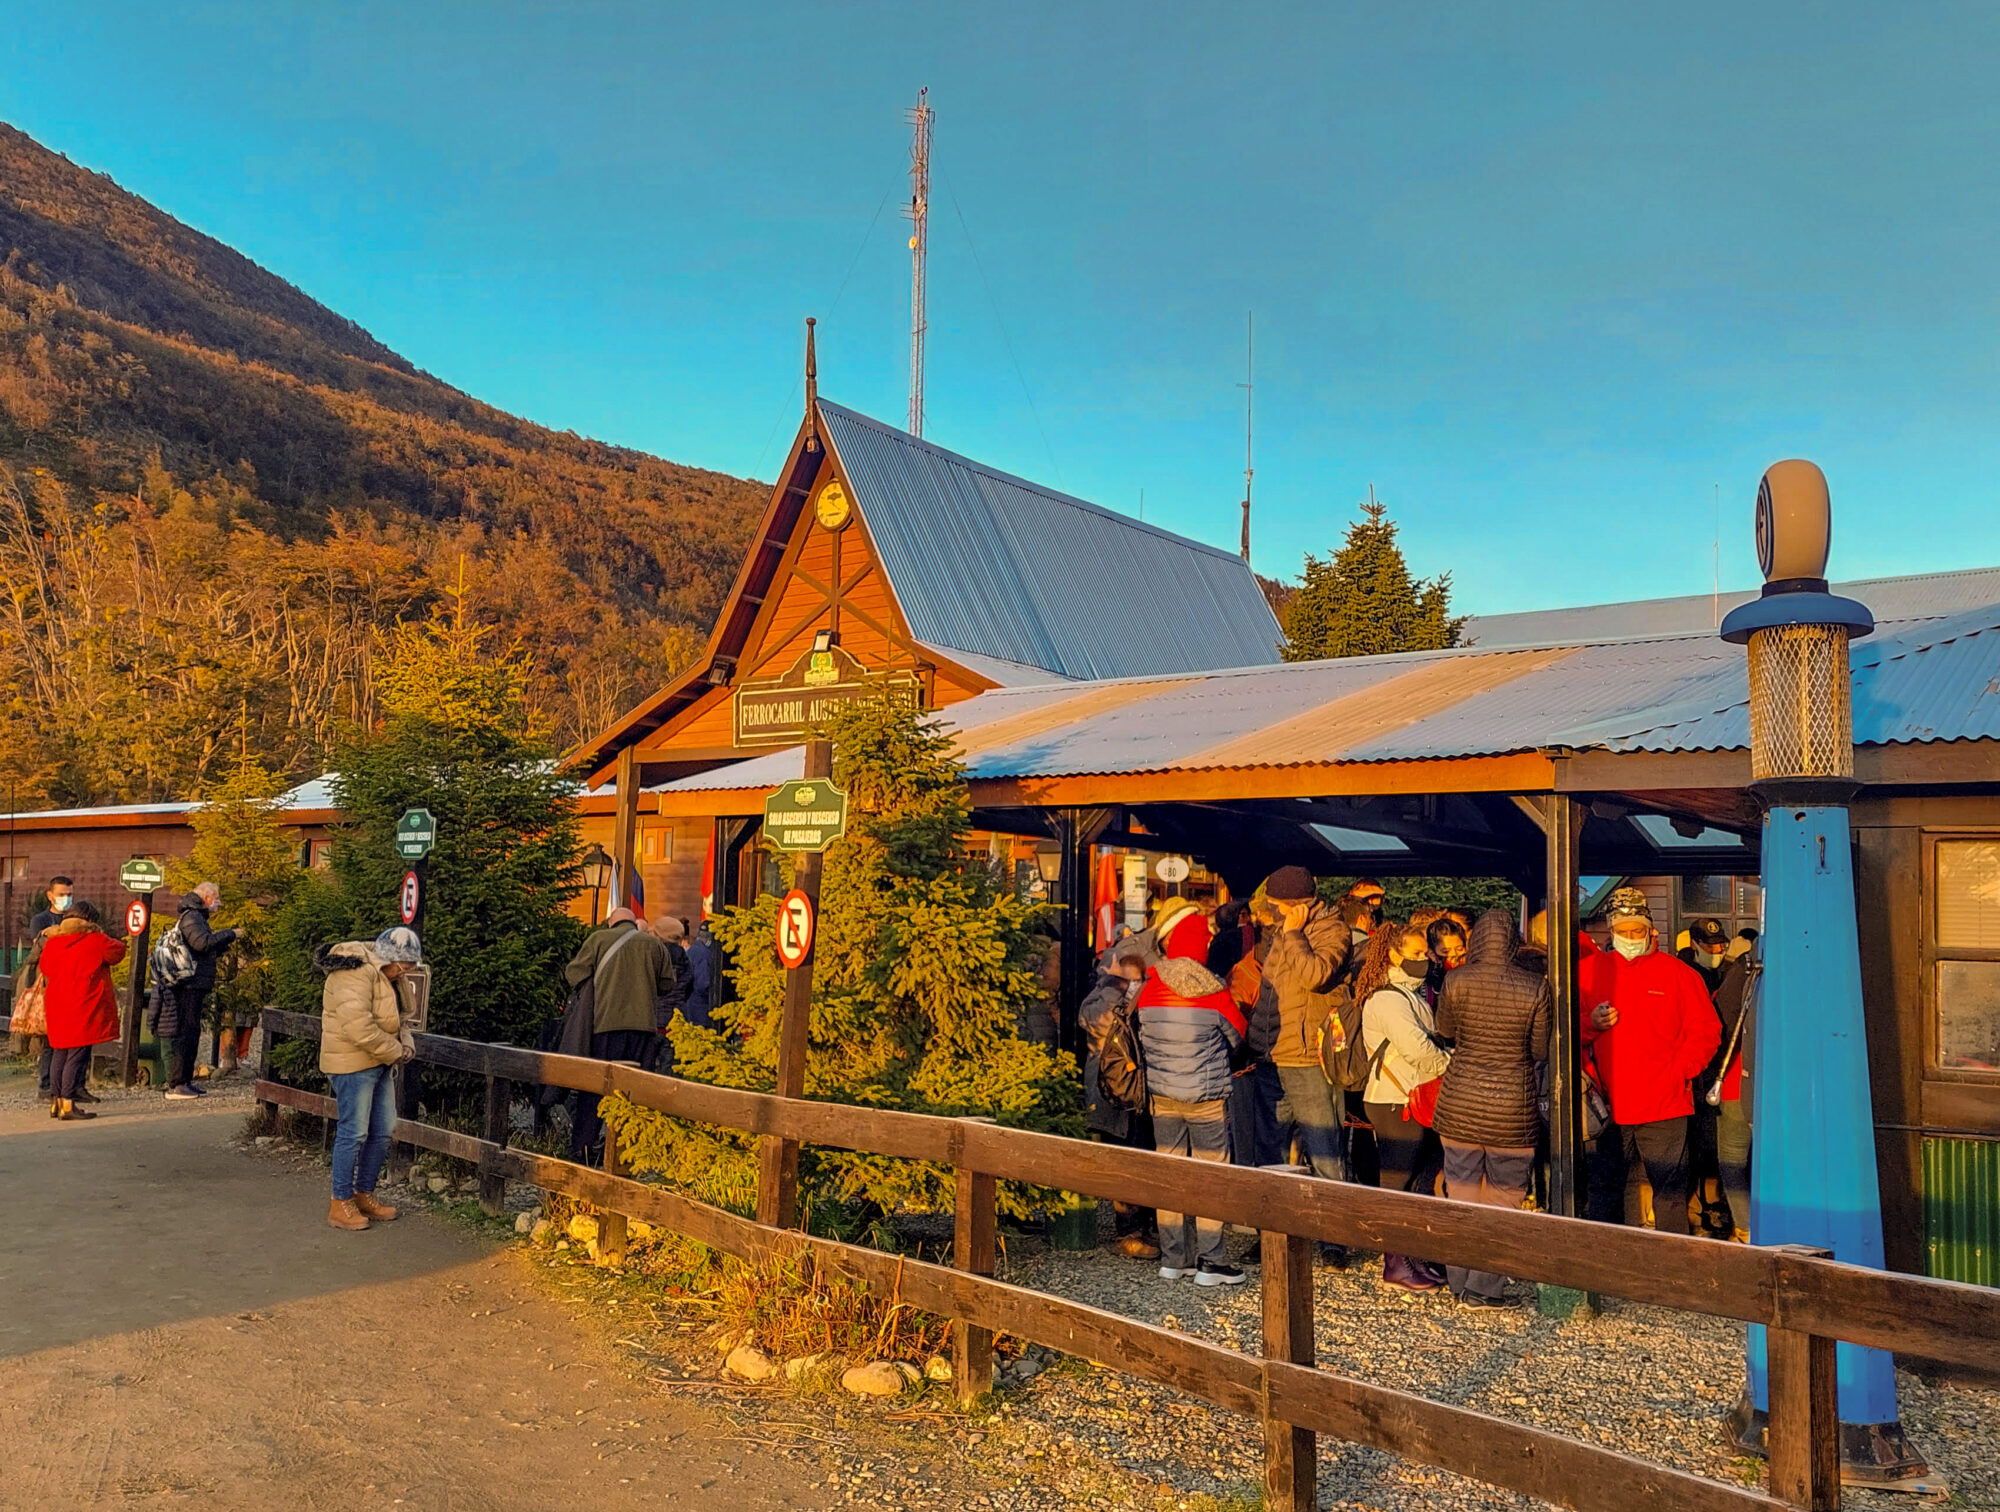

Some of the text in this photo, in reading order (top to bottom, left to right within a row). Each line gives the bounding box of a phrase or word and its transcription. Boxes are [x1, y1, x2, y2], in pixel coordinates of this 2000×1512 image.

[743, 701, 805, 726] FERROCARRIL
[807, 811, 811, 825] Y
[787, 909, 802, 948] E
